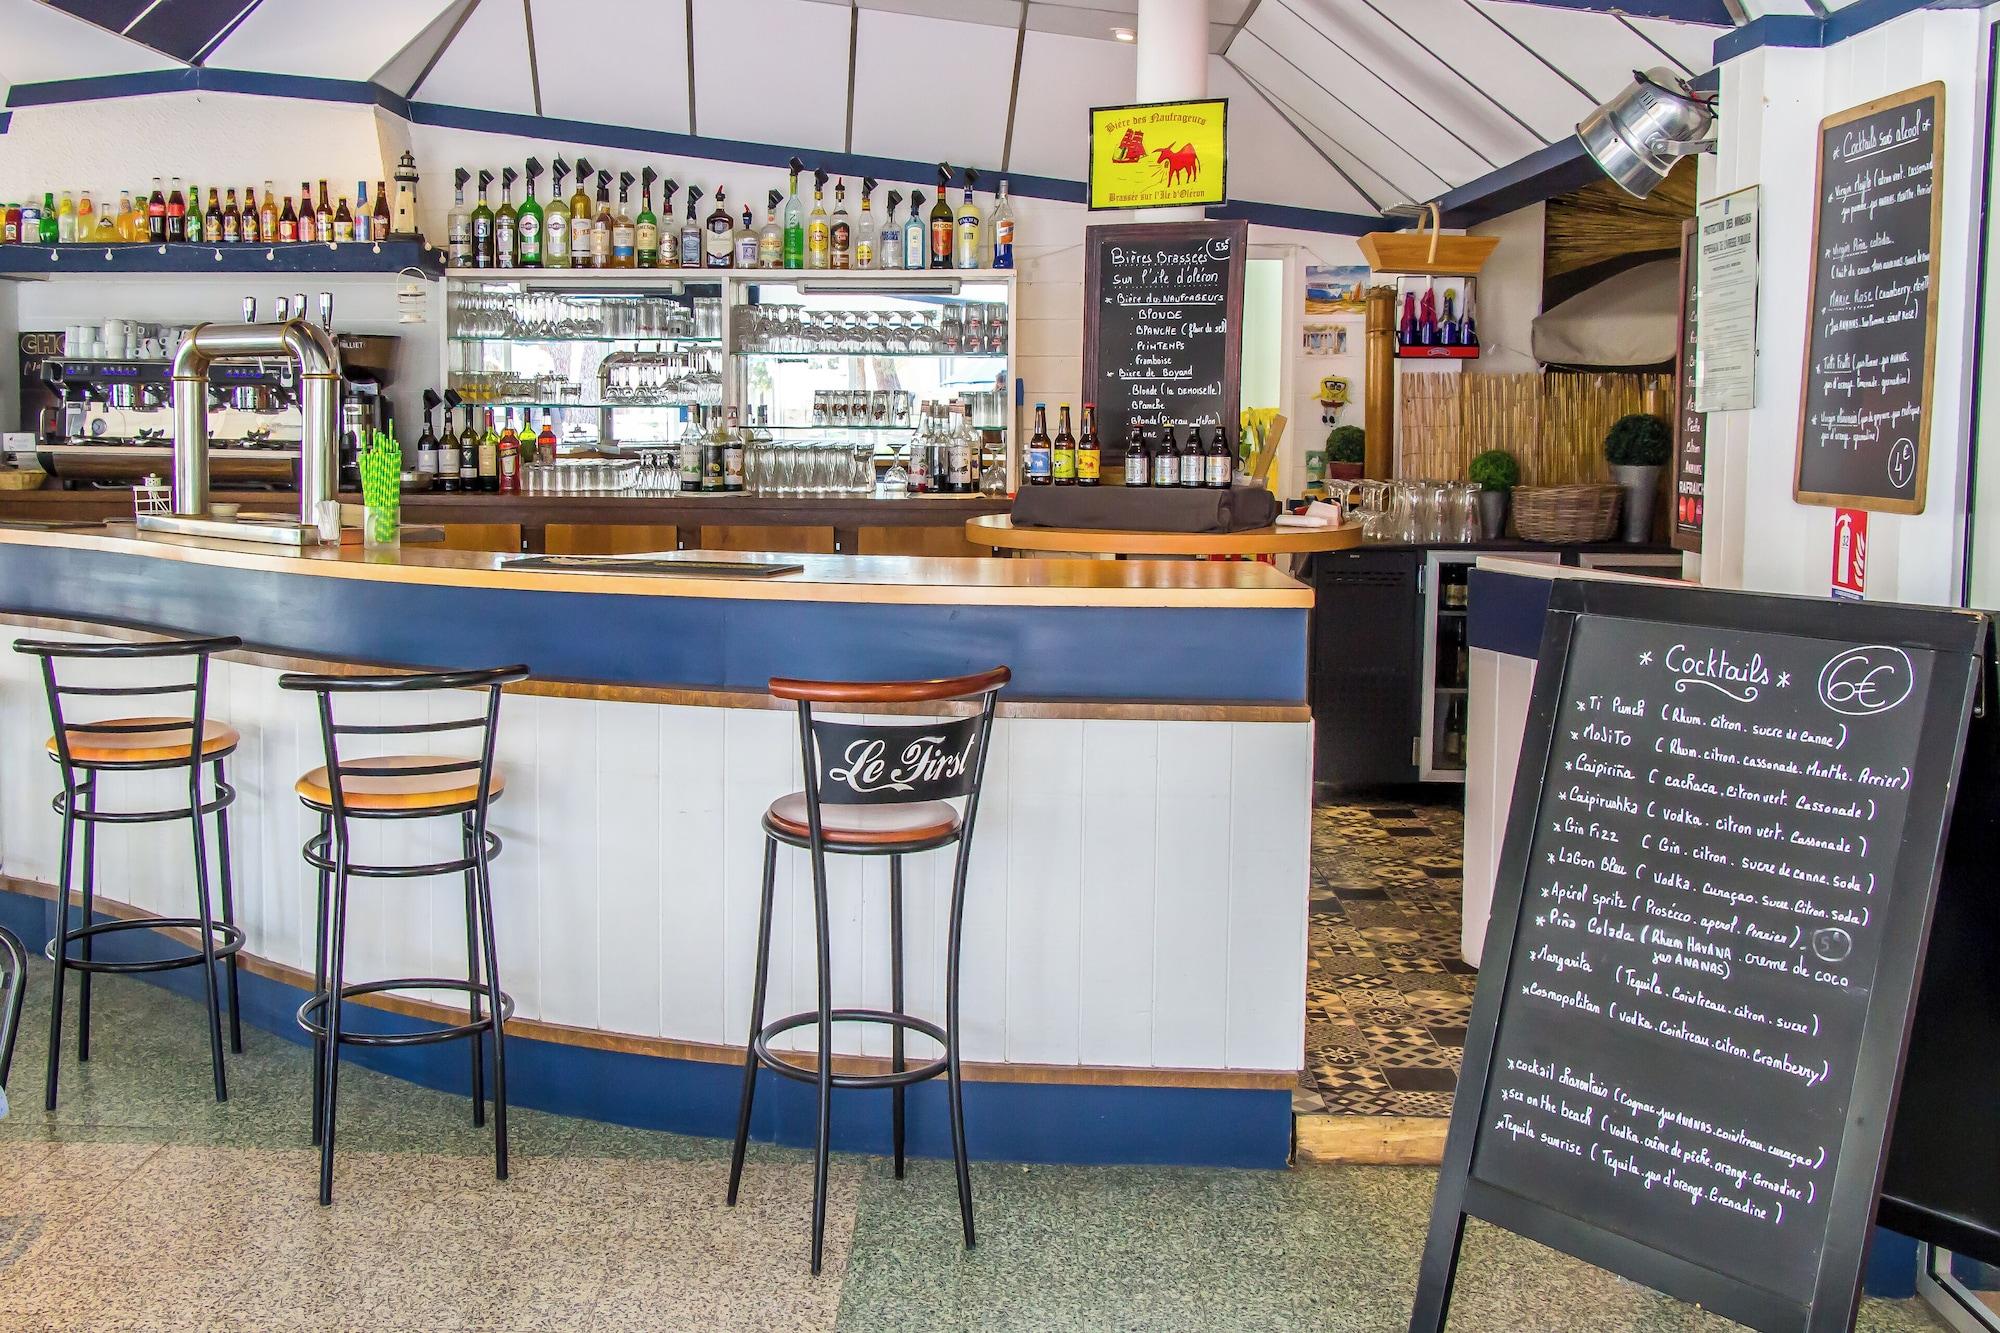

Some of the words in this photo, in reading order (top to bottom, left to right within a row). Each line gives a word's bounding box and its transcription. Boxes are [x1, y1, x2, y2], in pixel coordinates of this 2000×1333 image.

[1132, 113, 1147, 125] des
[1149, 112, 1206, 126] Naufrageurs
[1141, 193, 1152, 201] sur
[1111, 247, 1152, 264] Bières
[1145, 368, 1155, 377] de
[1666, 644, 1769, 685] Cocktails
[1612, 696, 1645, 717] Punch
[1752, 725, 1783, 738] sucre
[1786, 728, 1797, 740] de
[829, 740, 886, 792] Le
[890, 733, 976, 783] First
[1565, 817, 1584, 835] Gin
[1778, 862, 1791, 877] de
[1537, 944, 1592, 972] Margarita
[1587, 917, 1635, 942] Colada
[1793, 955, 1810, 977] de
[1530, 982, 1600, 1014] Cosmopolitan
[1503, 1113, 1536, 1141] Tequila
[1541, 1132, 1582, 1156] sunrise
[1527, 1096, 1537, 1107] on
[1540, 1094, 1557, 1114] the
[1561, 1100, 1593, 1126] beach
[1671, 1140, 1682, 1158] de
